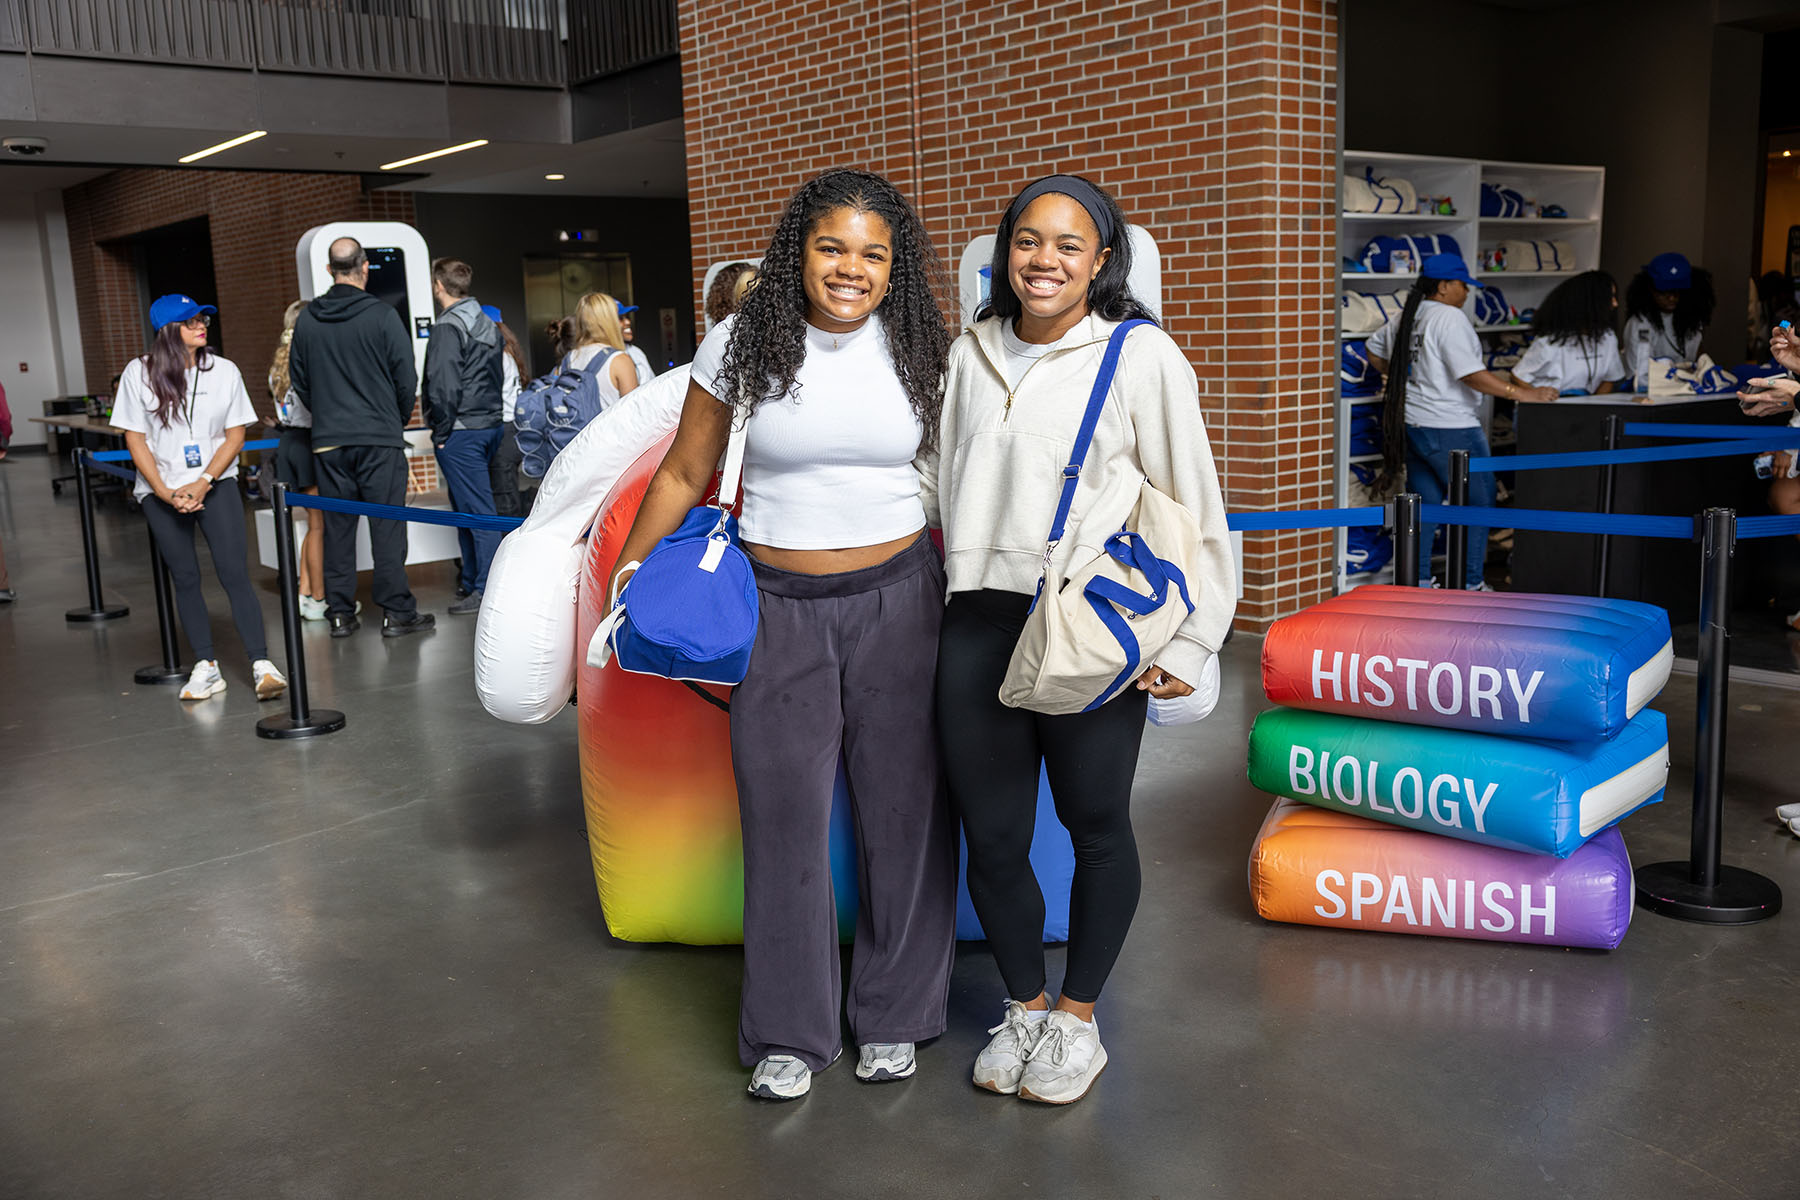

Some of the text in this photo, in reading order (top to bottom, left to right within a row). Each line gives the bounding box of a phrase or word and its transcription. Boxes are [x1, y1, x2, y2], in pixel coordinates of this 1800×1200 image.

[1311, 649, 1544, 723] HISTORY
[1289, 745, 1499, 833] BIOLOGY
[1314, 869, 1556, 936] SPANISH
